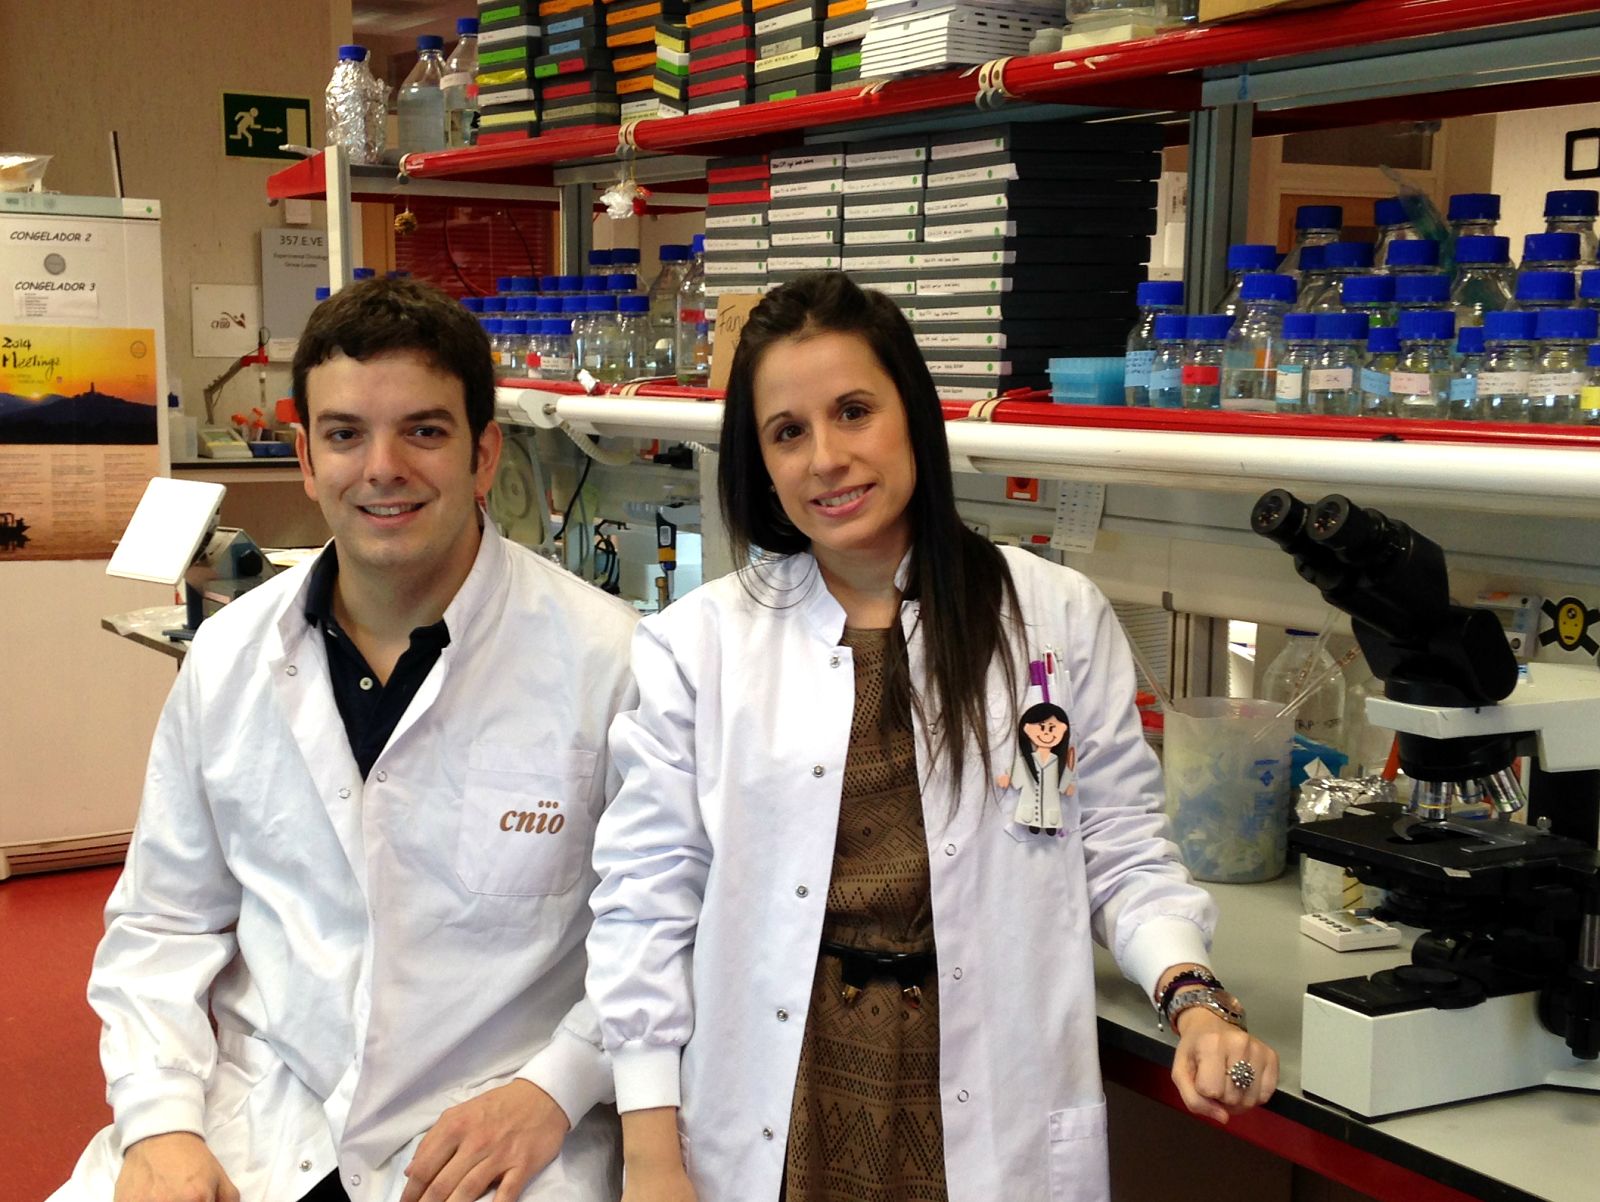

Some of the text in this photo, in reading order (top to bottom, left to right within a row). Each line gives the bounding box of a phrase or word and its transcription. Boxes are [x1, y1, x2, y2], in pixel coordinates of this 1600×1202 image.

[10, 231, 92, 242] CONGELADOR 2
[15, 281, 96, 291] CONGELADOR 3
[2, 336, 32, 351] 2014
